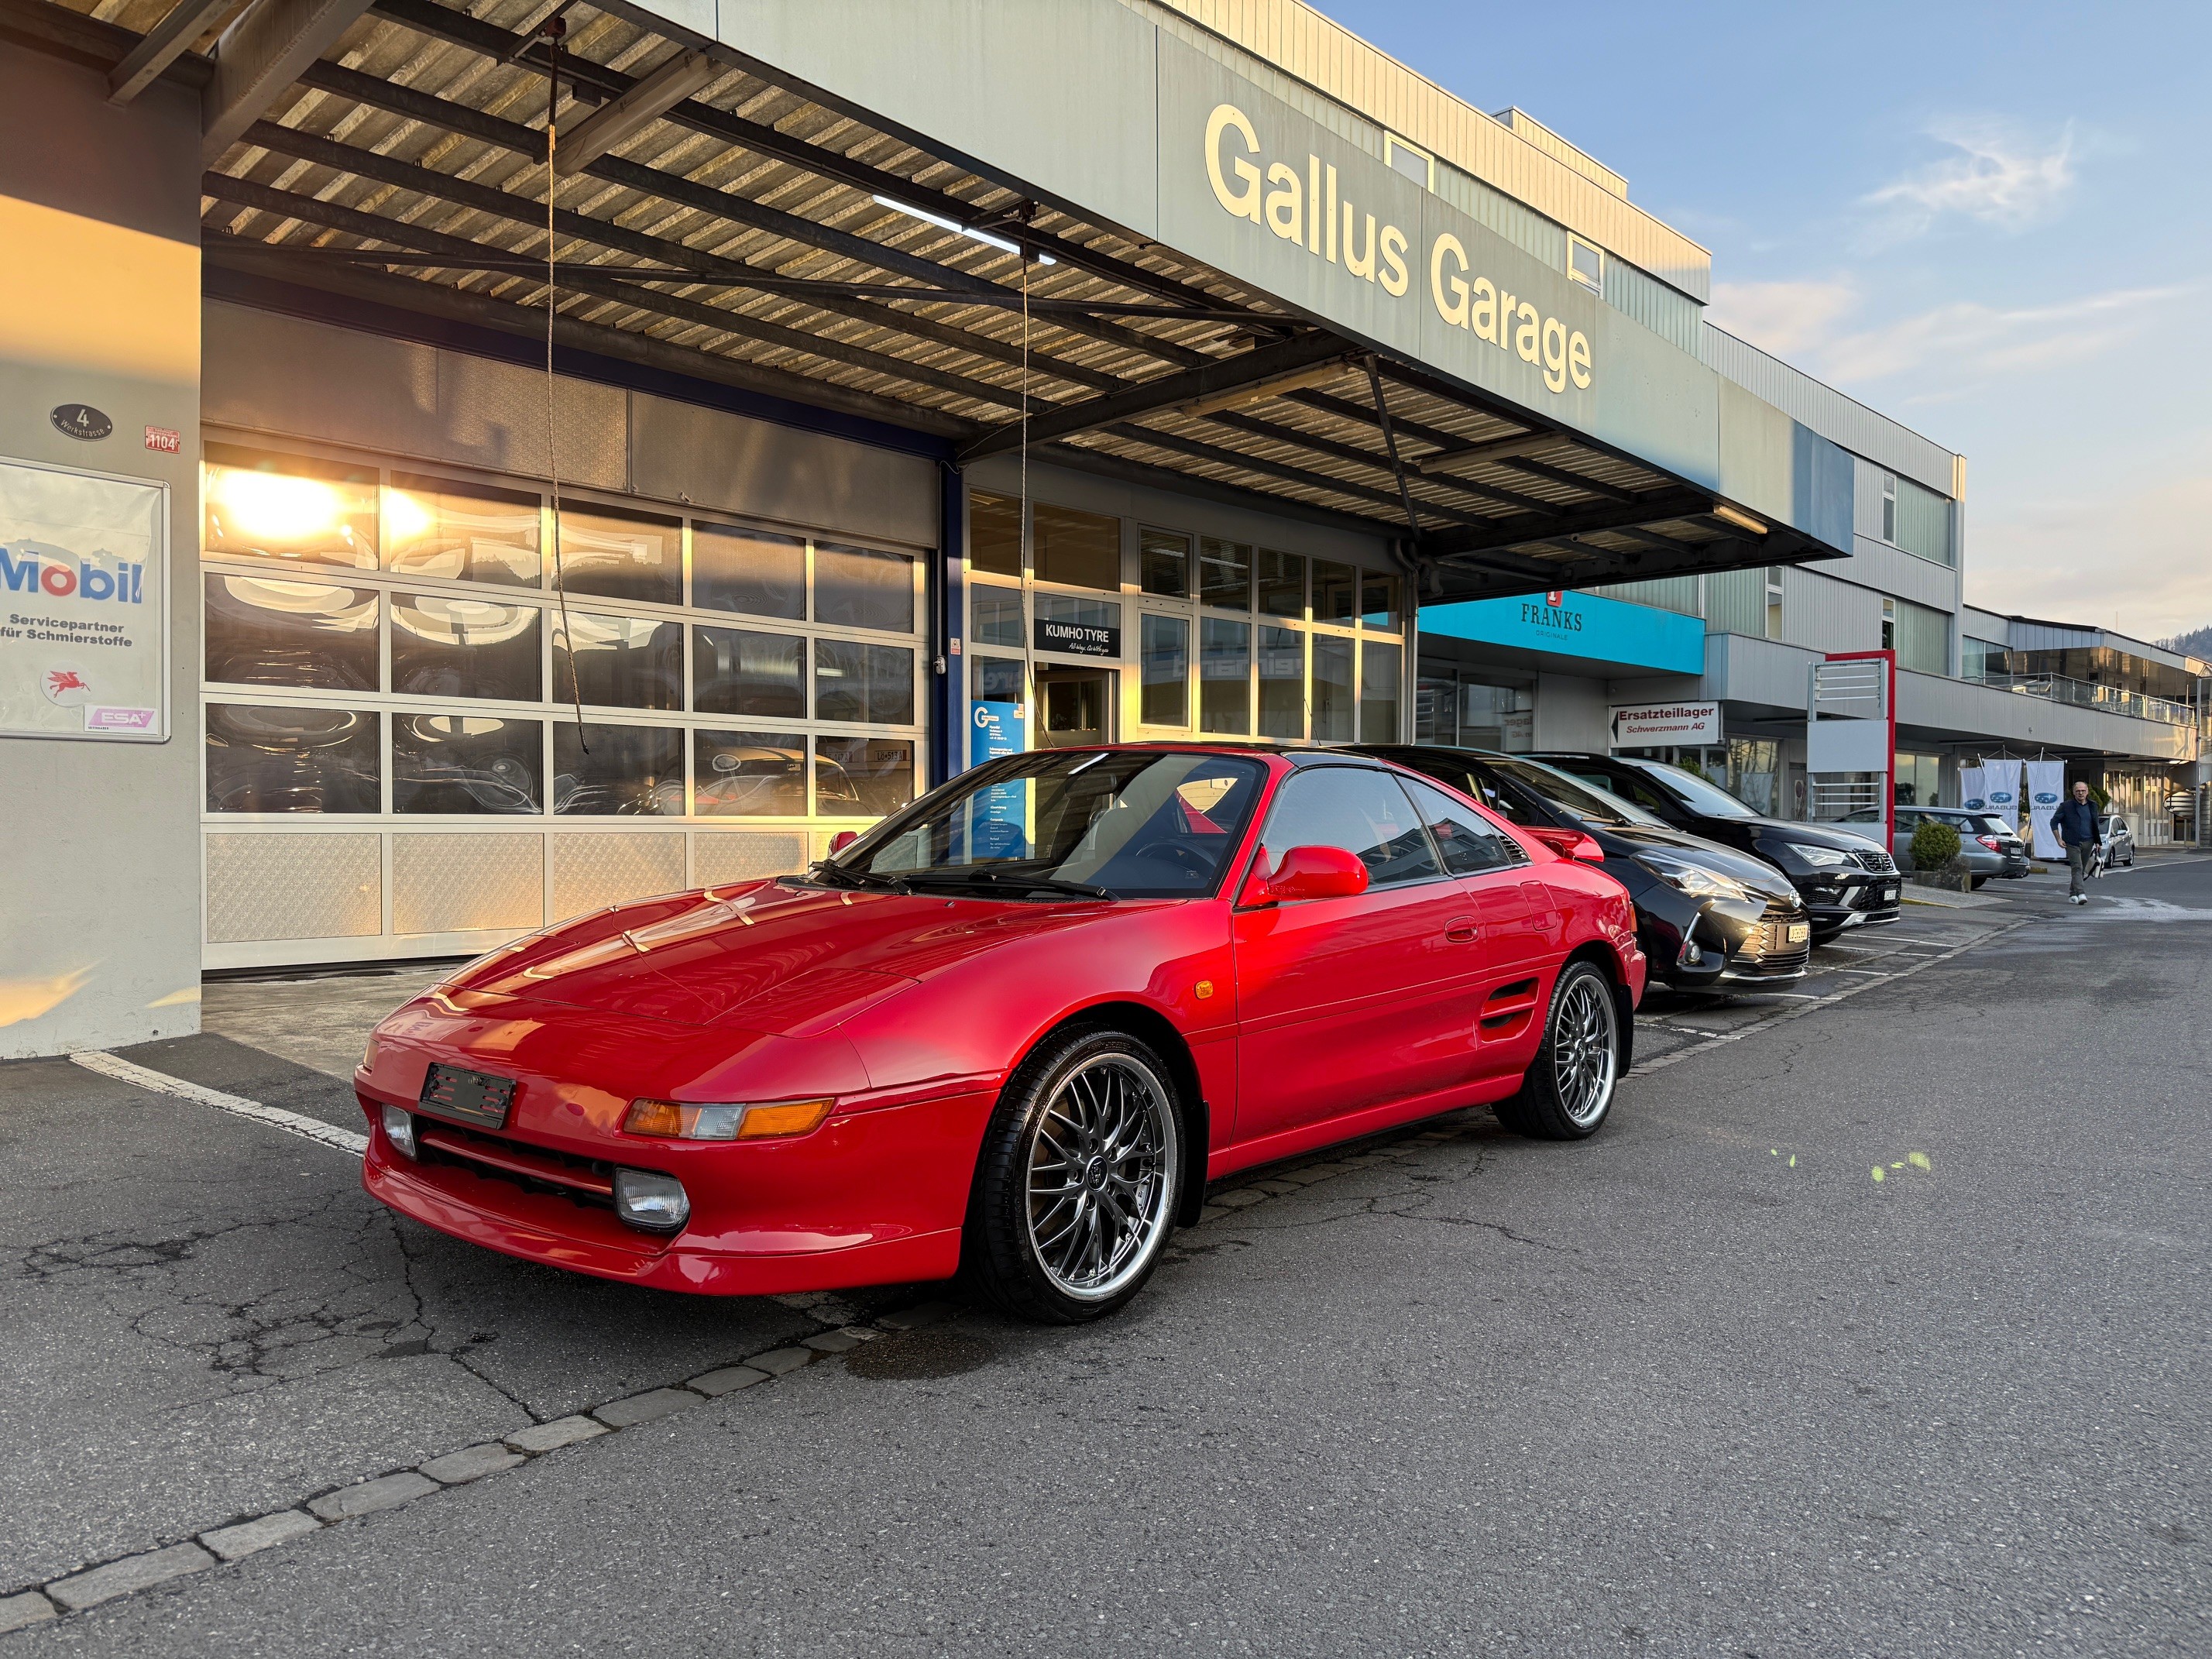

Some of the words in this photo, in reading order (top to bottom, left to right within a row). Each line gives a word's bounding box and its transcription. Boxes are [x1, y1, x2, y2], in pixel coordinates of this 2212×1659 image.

[1204, 103, 1409, 297] Gallus
[1430, 232, 1592, 393] Garage
[76, 408, 90, 427] 4
[60, 419, 105, 438] Werkstrasse
[150, 434, 175, 451] 1104
[0, 547, 143, 604] Mobil
[9, 613, 125, 633] Servicepartner
[1521, 603, 1582, 632] FRANKS
[0, 627, 22, 638] für
[26, 629, 132, 647] Schmierstoffe
[1046, 623, 1084, 640] KUMHO
[1084, 628, 1109, 643] TYRE
[1536, 630, 1568, 641] ORIGINALE
[1619, 707, 1715, 721] Ersatzteillager
[1626, 724, 1689, 733] Schwerzmann
[1691, 722, 1705, 730] AG
